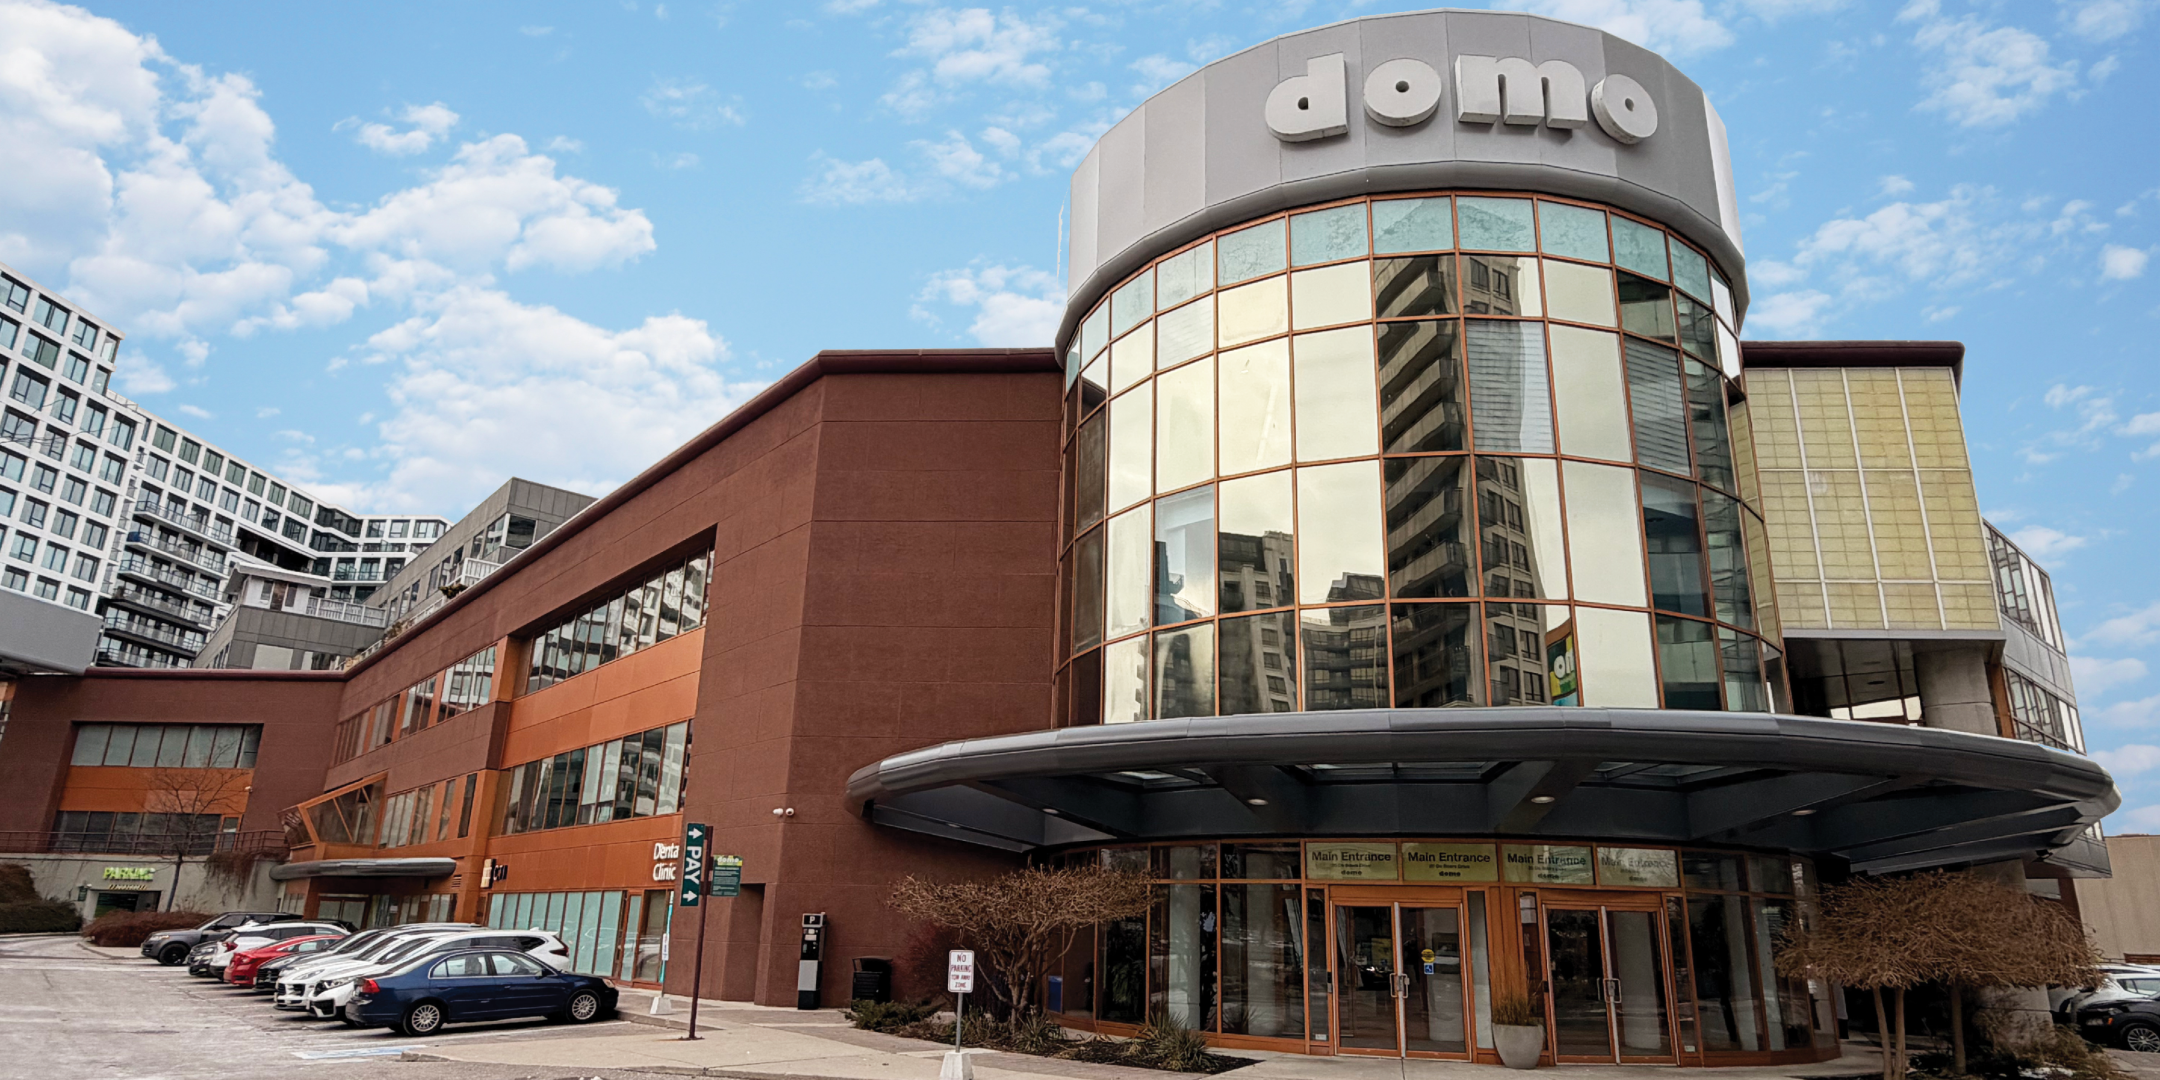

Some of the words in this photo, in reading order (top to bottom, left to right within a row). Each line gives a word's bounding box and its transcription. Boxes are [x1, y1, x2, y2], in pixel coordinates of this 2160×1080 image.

[1265, 52, 1658, 144] domo
[717, 855, 740, 863] domo
[1312, 851, 1338, 861] Main
[1341, 852, 1391, 861] Entrance
[1408, 852, 1435, 862] Main
[1439, 852, 1491, 862] Entrance
[1507, 853, 1534, 863] Main
[1537, 854, 1586, 865] Entrance
[653, 861, 677, 881] Clinic
[684, 846, 702, 885] PAY
[103, 867, 154, 880] PARKING
[956, 954, 967, 962] NO
[951, 964, 972, 972] PARKING
